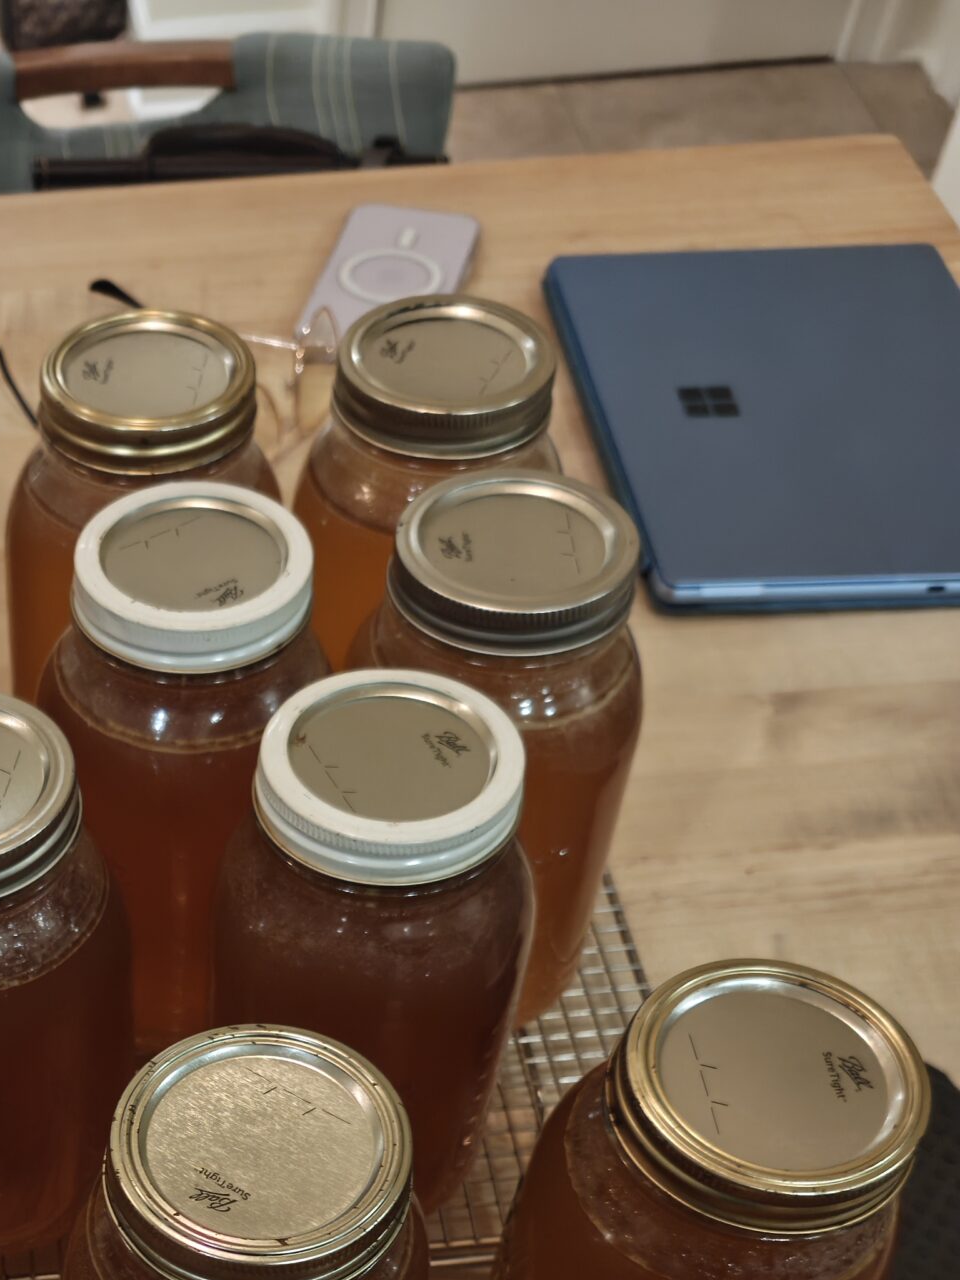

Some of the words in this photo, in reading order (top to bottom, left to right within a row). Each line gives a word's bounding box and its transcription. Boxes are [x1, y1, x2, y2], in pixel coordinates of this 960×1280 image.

[434, 731, 471, 757] Ball
[822, 1051, 846, 1102] SureTight
[837, 1055, 874, 1092] Ball
[188, 1187, 238, 1213] Ball
[194, 1167, 252, 1201] SureTight
